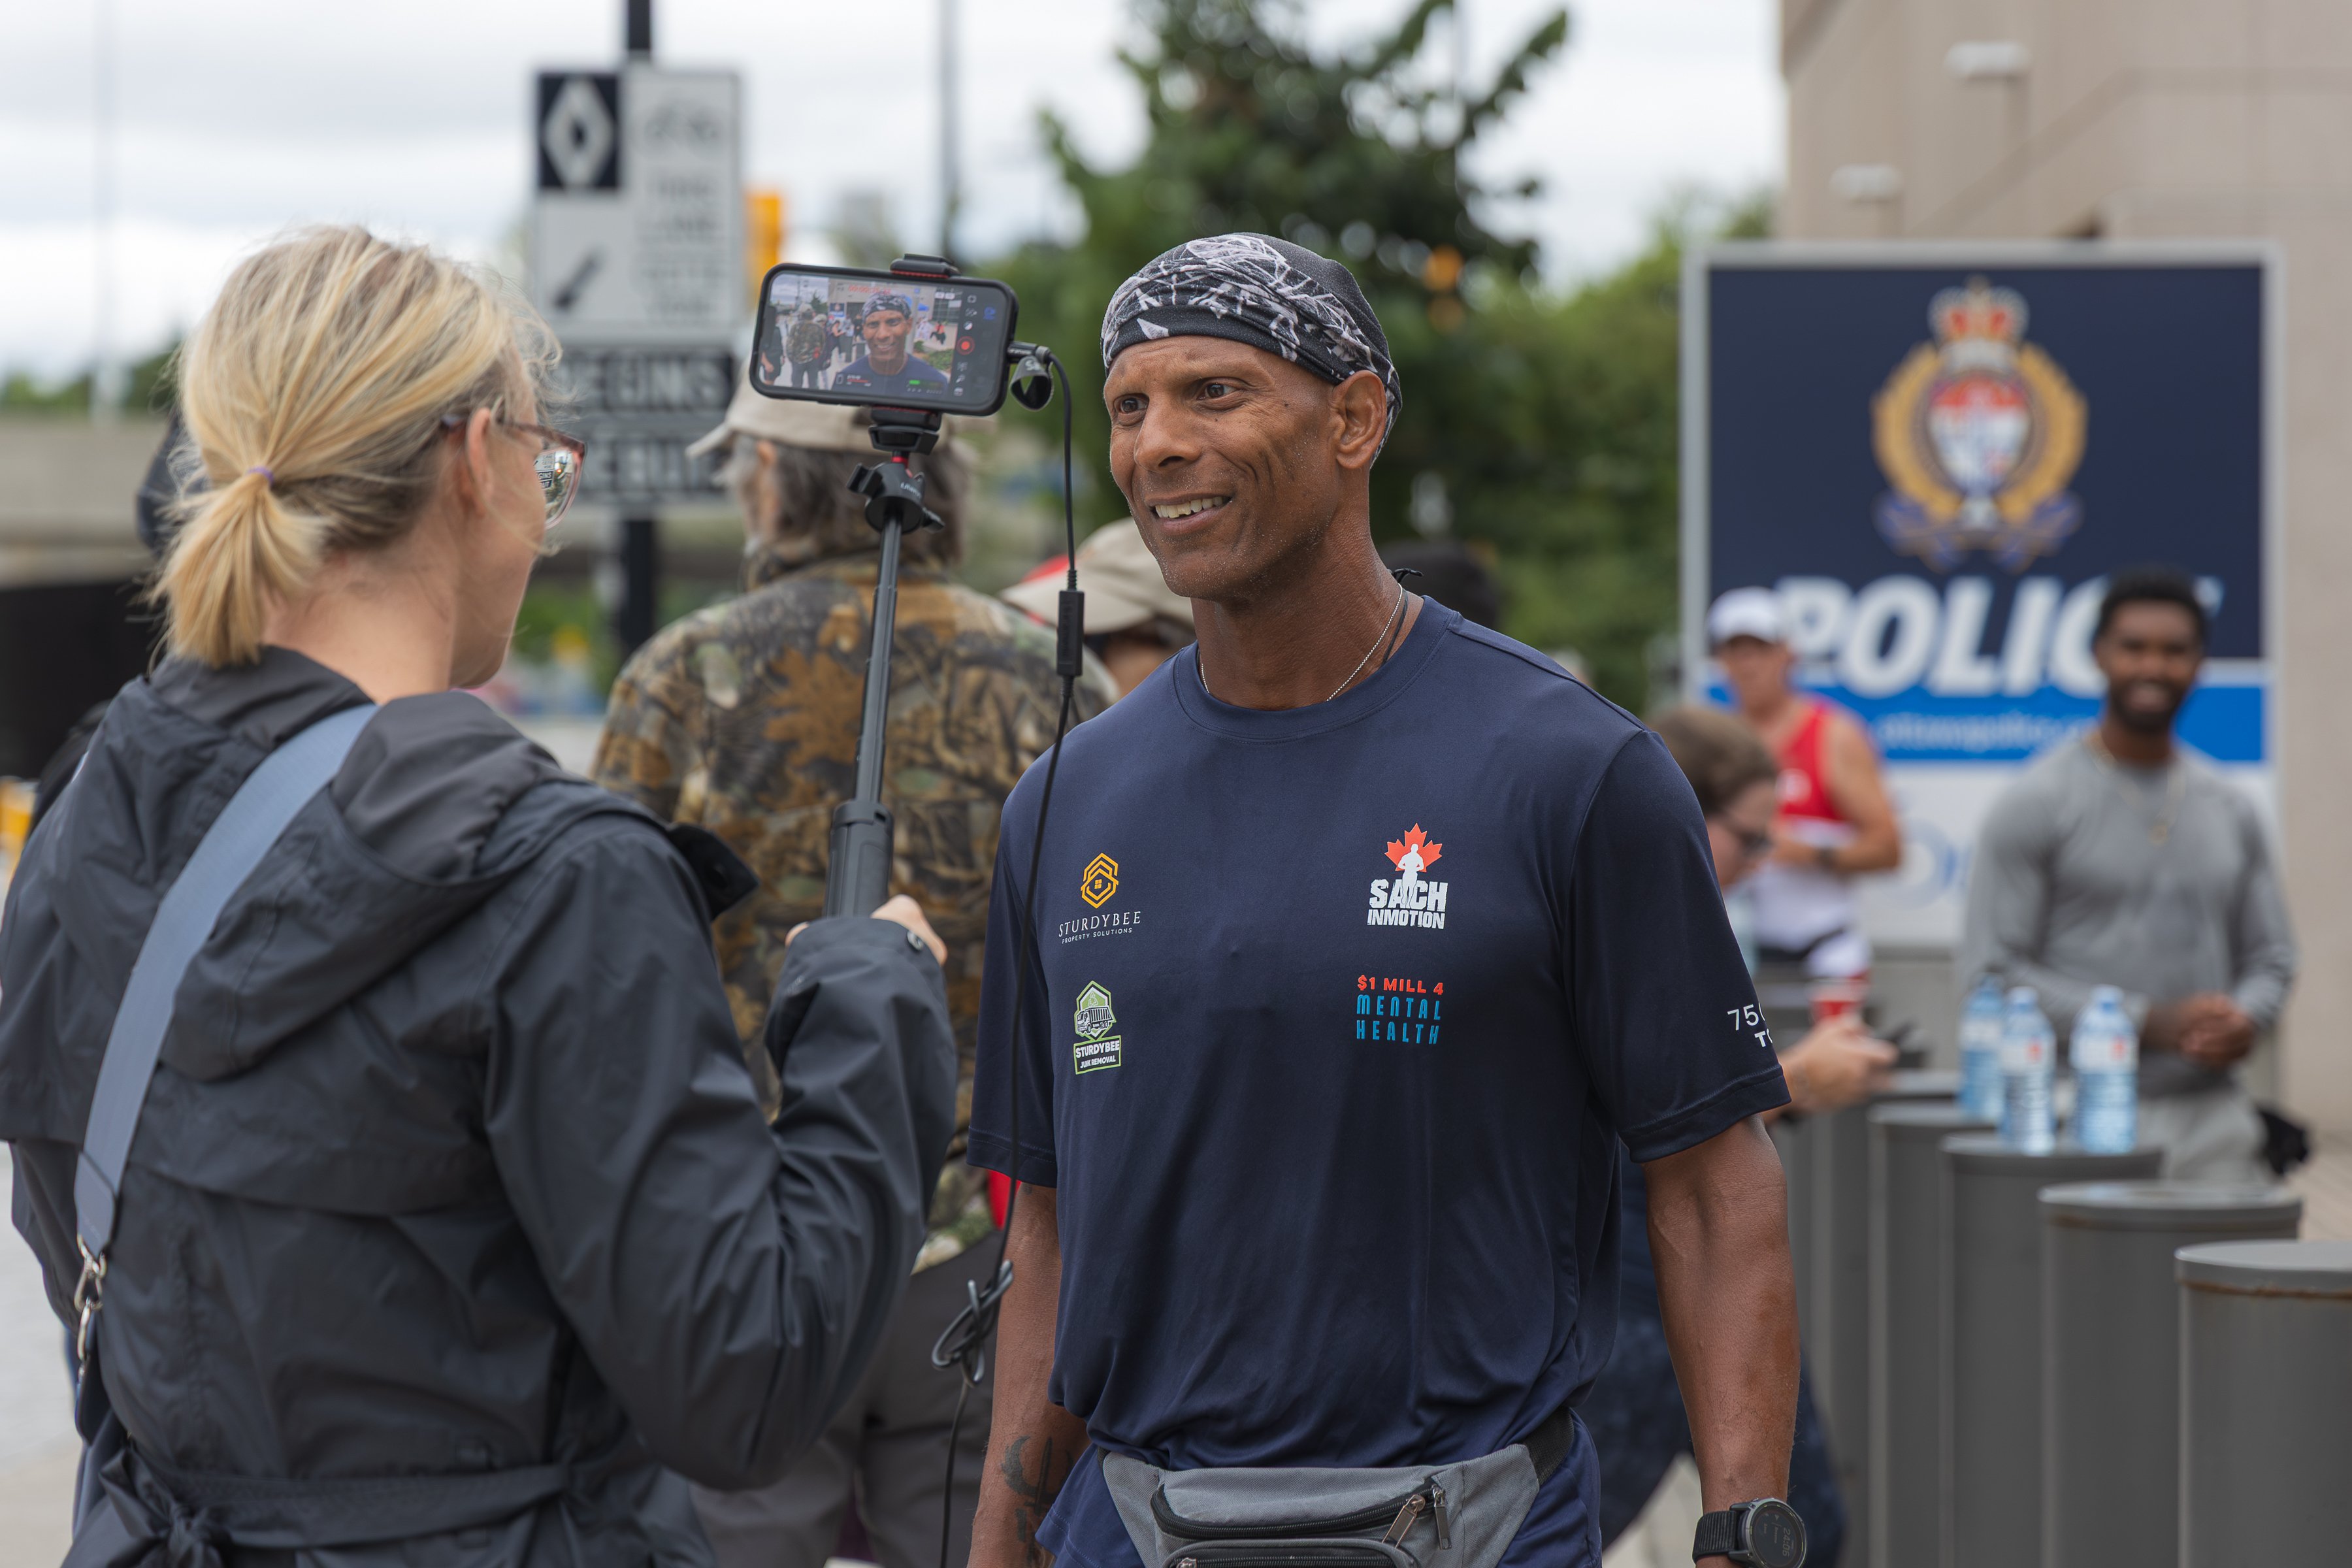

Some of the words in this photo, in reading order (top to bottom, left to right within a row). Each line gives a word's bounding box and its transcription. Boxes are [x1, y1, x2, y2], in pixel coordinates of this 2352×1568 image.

[1776, 575, 2221, 698] POLIC
[1369, 879, 1448, 912] SACH
[1058, 911, 1141, 938] STURDYBEE
[1367, 909, 1446, 929] INMOTION
[1062, 933, 1090, 944] PROPERTY
[1092, 927, 1132, 938] SOLUTIONS
[1357, 974, 1376, 991] $1
[1383, 977, 1427, 994] MILL
[1433, 982, 1444, 996] 4
[1356, 994, 1441, 1021] MENTAL
[1727, 1002, 1765, 1031] 75
[1356, 1019, 1439, 1045] HEALTH
[1754, 1028, 1773, 1047] T
[1075, 1040, 1120, 1058] STURDYBEE
[1080, 1058, 1091, 1069] JUNK
[1091, 1055, 1117, 1066] REMOVAL
